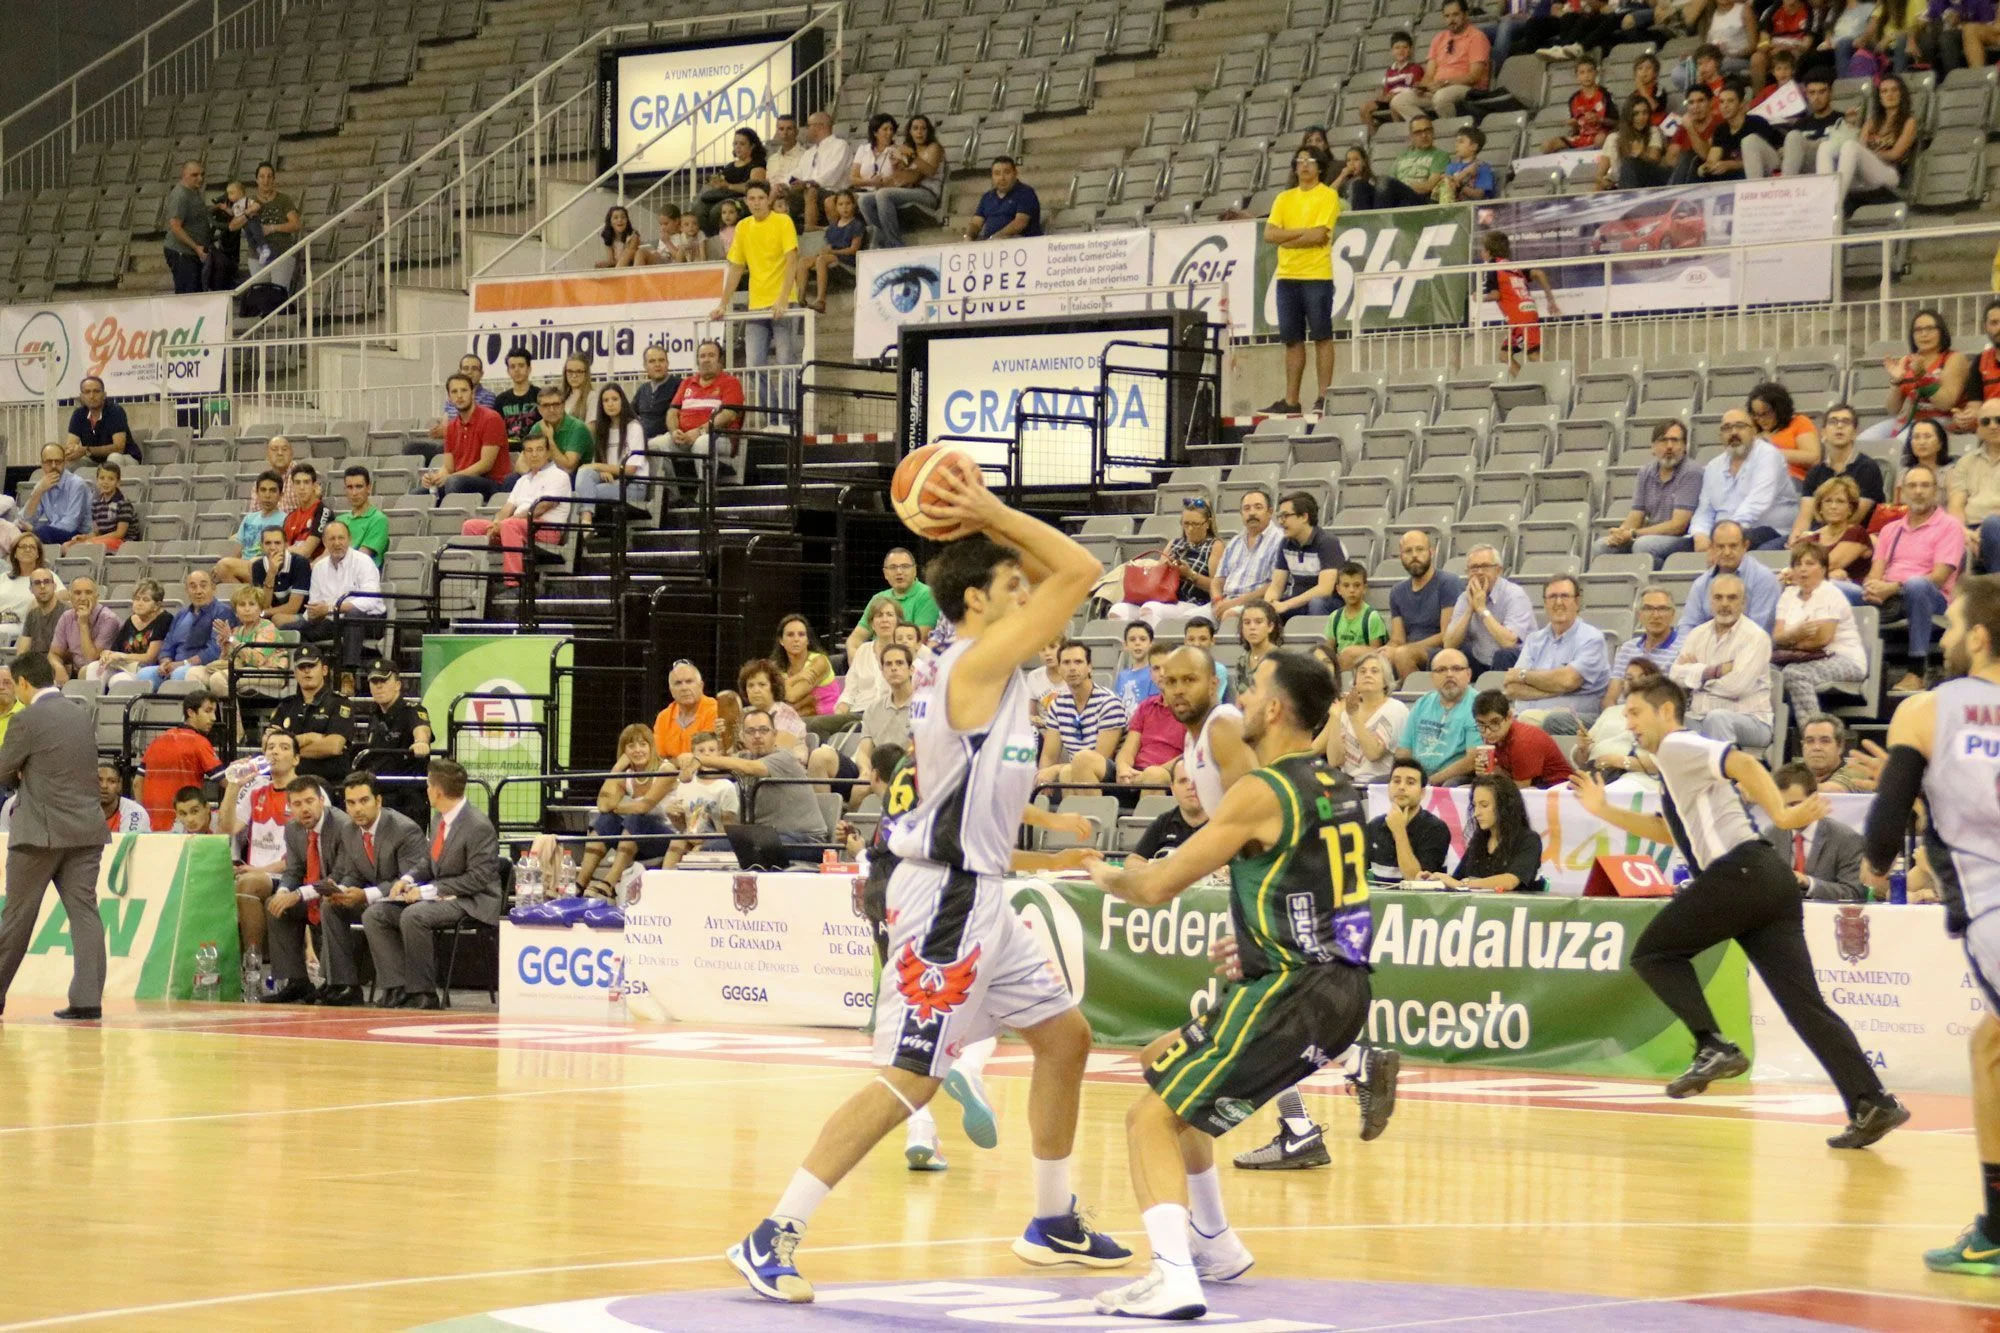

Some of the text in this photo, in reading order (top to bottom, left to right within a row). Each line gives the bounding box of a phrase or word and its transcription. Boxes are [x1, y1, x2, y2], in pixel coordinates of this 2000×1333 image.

[664, 65, 731, 81] AYUNTAMIENTO
[629, 86, 779, 131] GRANADA
[1048, 241, 1085, 253] Reformas
[949, 248, 1027, 272] GRUPO
[1047, 249, 1127, 264] Locales Comerciales
[1098, 261, 1128, 274] propias
[947, 270, 1026, 294] LÓPEZ
[1035, 277, 1075, 290] Proyectos
[1077, 277, 1087, 287] de
[159, 359, 201, 380] PORT
[992, 356, 1084, 373] AYUNTAMIENTO
[943, 383, 1150, 434] GRANADA
[1319, 821, 1370, 908] 13
[703, 915, 788, 934] AYUNTAMIENTO
[710, 934, 782, 951] DE GRANADA
[1369, 903, 1625, 972] Andaluza
[829, 940, 874, 957] DE GRA
[744, 961, 755, 971] DE
[757, 960, 800, 974] DEPORTES
[1831, 987, 1900, 1008] GRANADA
[1356, 990, 1530, 1050] ncesto
[1870, 1018, 1926, 1034] DEPORTES
